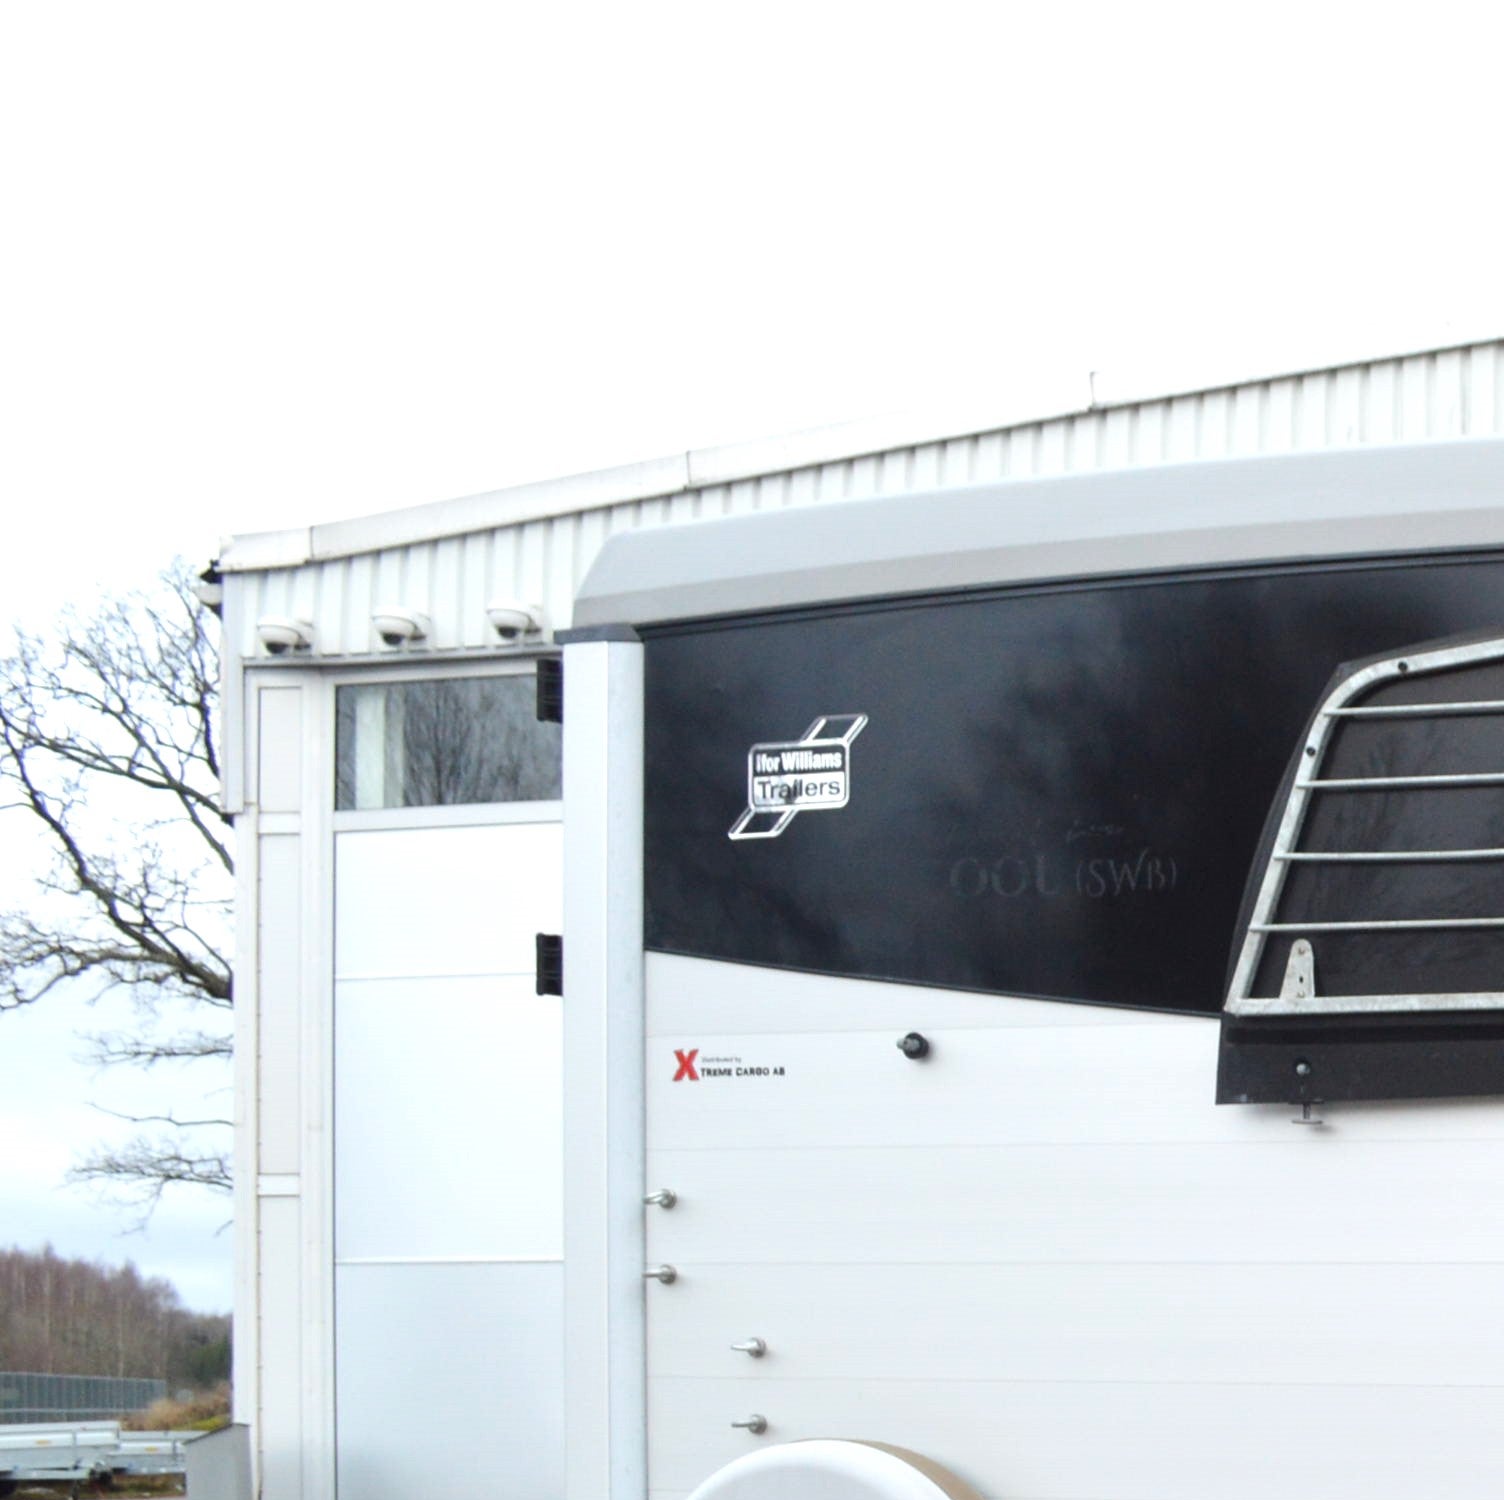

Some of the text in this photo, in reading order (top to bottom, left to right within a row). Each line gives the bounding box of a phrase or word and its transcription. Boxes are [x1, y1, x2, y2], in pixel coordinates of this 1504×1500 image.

[755, 751, 843, 774] Ifor Williams
[757, 778, 841, 800] Trailers
[736, 1067, 770, 1077] CARGO
[772, 1067, 785, 1076] AB
